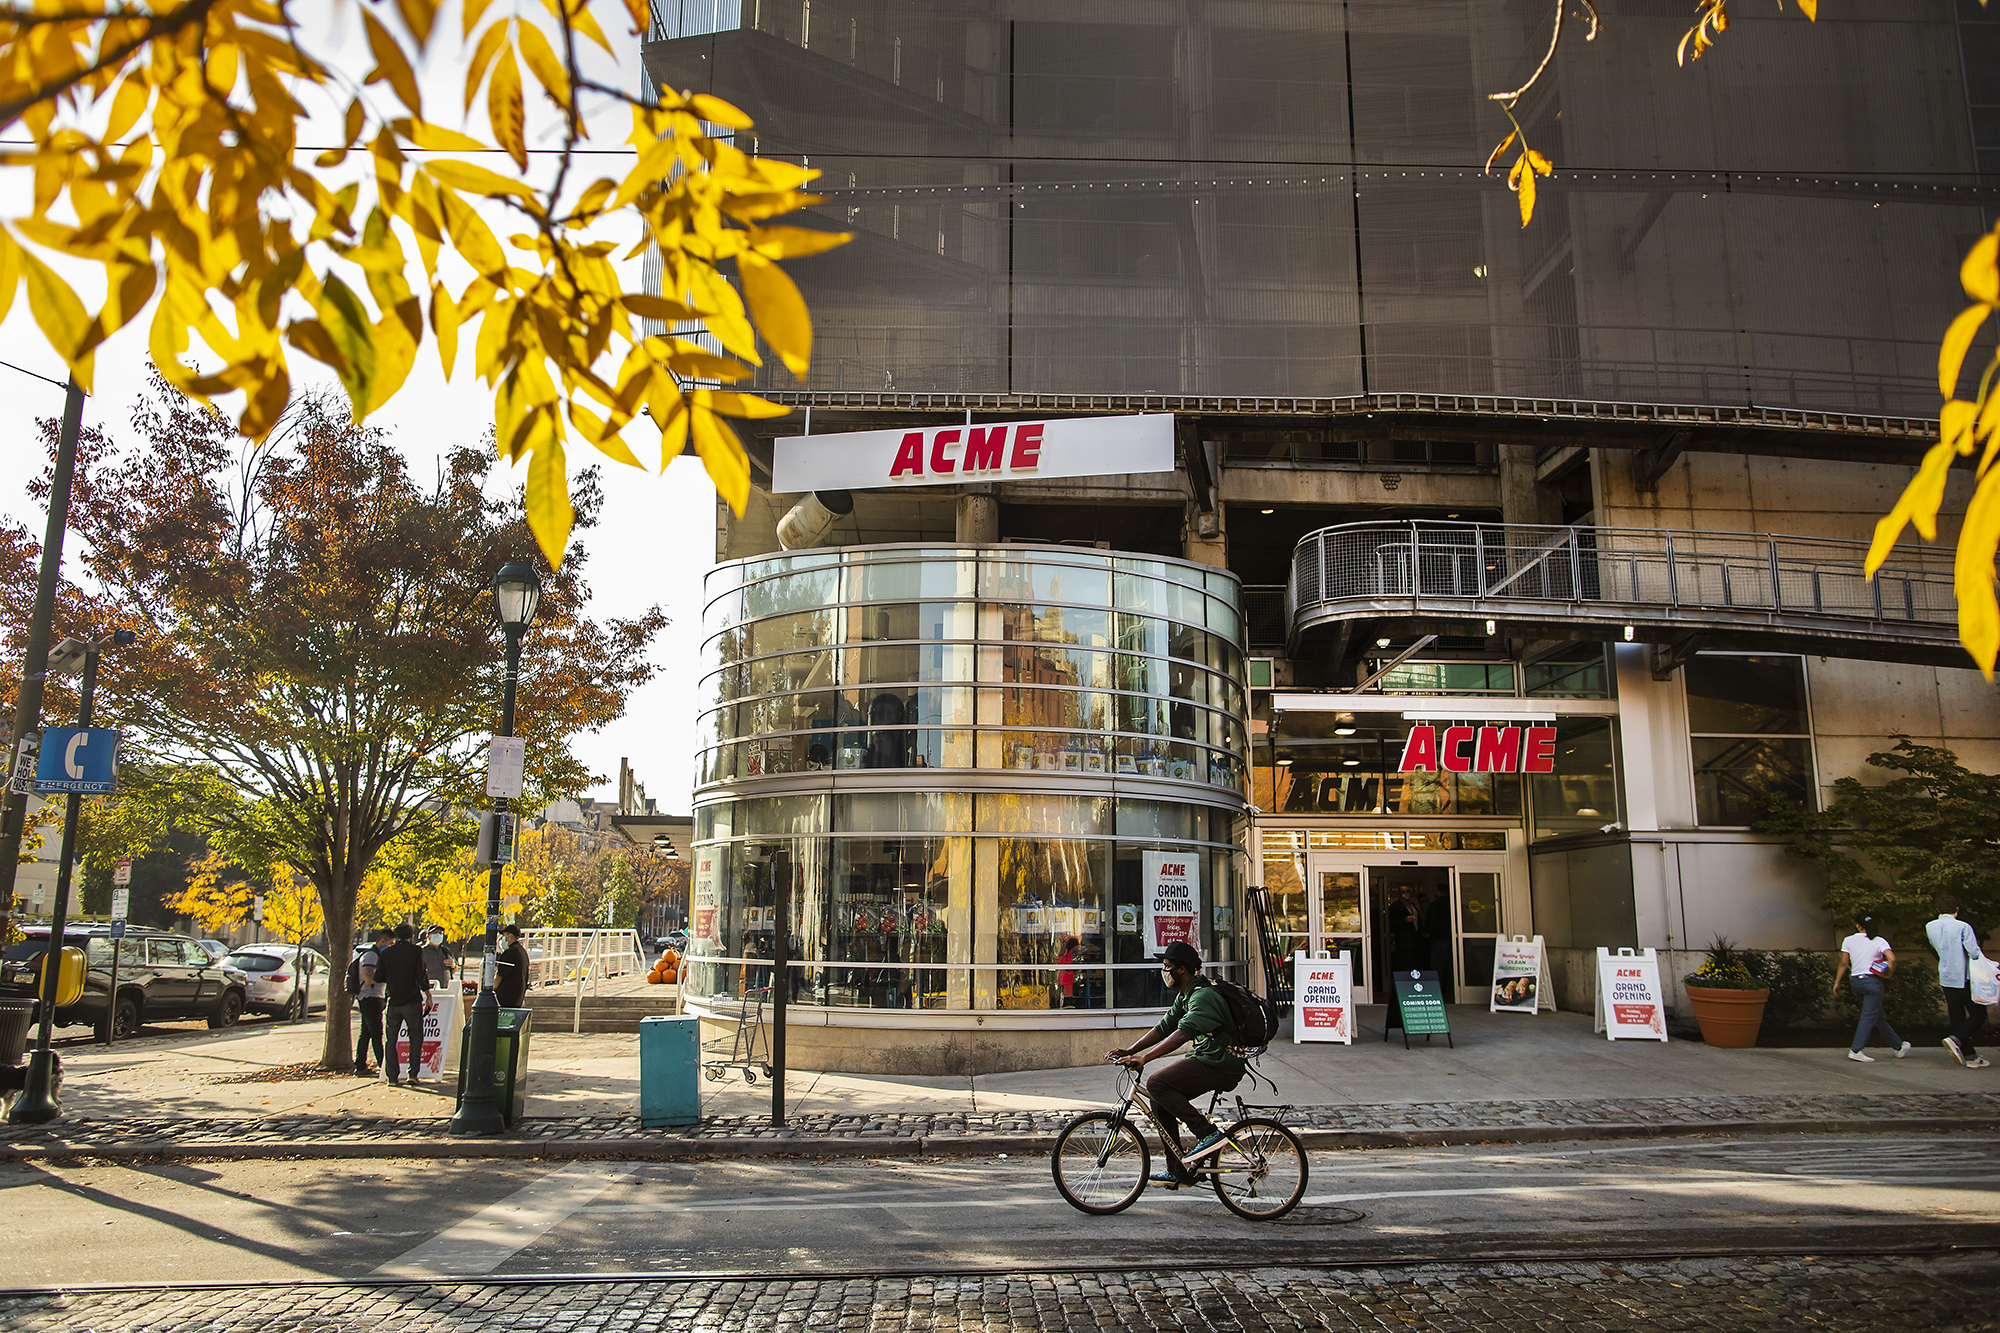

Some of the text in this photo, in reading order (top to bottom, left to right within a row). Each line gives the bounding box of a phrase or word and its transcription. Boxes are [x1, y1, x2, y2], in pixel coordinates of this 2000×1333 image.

[889, 423, 1045, 480] ACME
[1398, 725, 1557, 774] ACME
[20, 755, 31, 767] WE
[492, 756, 520, 765] STOING
[498, 767, 513, 776] BS
[495, 776, 515, 786] ZNE
[40, 782, 104, 790] EMERGENCY
[1160, 864, 1186, 876] ACME
[1158, 884, 1189, 898] GRAND
[1153, 899, 1192, 912] OPENING
[1310, 972, 1334, 980] ACME
[1616, 969, 1642, 977] ACME
[1308, 986, 1336, 994] GRAND
[1616, 983, 1646, 991] GRAND
[1304, 995, 1340, 1004] OPENING
[1613, 992, 1651, 1000] OPENING
[400, 1028, 440, 1037] OING
[1147, 1111, 1184, 1158] ROADMASTE
